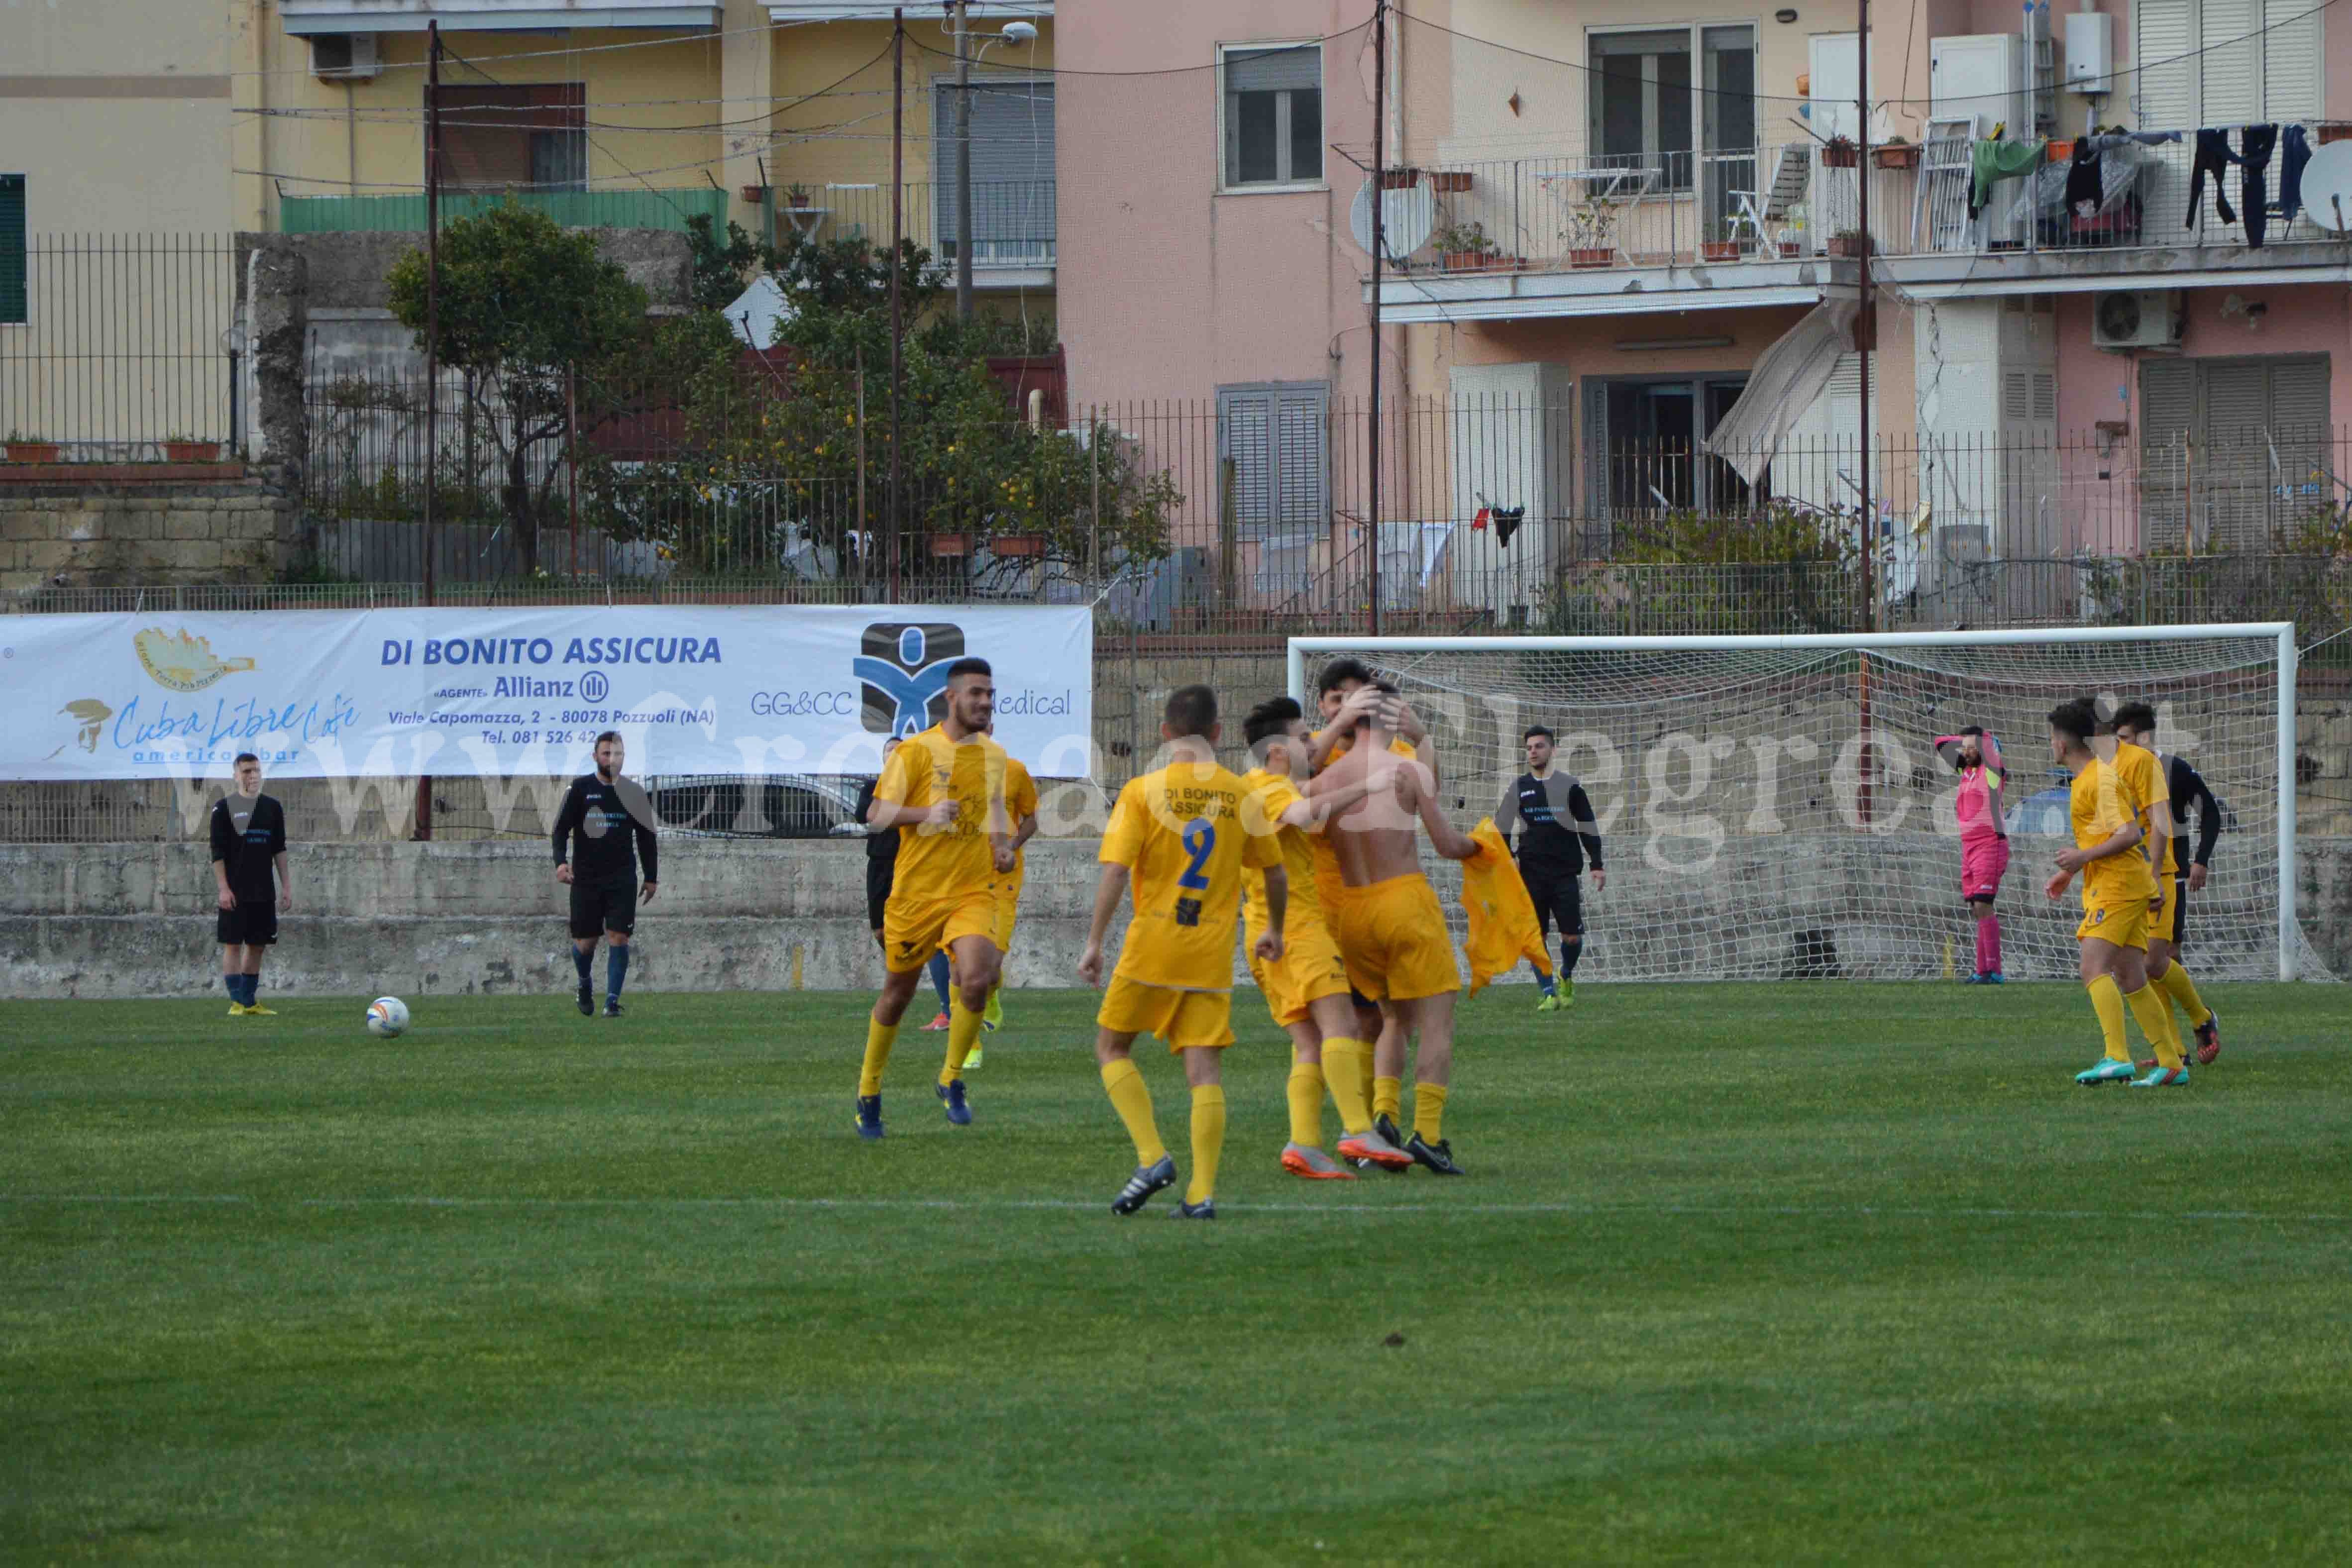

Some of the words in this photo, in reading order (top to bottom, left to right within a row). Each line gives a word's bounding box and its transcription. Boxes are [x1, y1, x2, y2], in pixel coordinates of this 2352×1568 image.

[381, 639, 413, 665] DI
[423, 638, 553, 664] BONITO
[562, 637, 721, 663] ASSICURA
[494, 676, 574, 697] Allianz
[751, 691, 853, 715] GG&CC
[991, 689, 1070, 715] edical
[114, 695, 207, 748] Cuba
[208, 697, 304, 747] Libre
[389, 711, 424, 724] Viale
[429, 711, 526, 727] Capomazza,
[531, 711, 540, 723] 2
[561, 710, 608, 723] 80078
[613, 710, 675, 723] Pozzuoli
[680, 710, 714, 726] (NA)
[482, 731, 506, 744] Tel.
[513, 731, 538, 743] 081
[545, 731, 573, 743] 526
[259, 747, 299, 761] bar
[1163, 788, 1178, 799] DI
[1183, 788, 1236, 804] BONITO
[1164, 802, 1235, 819] ASSICURA
[1178, 817, 1216, 890] 2
